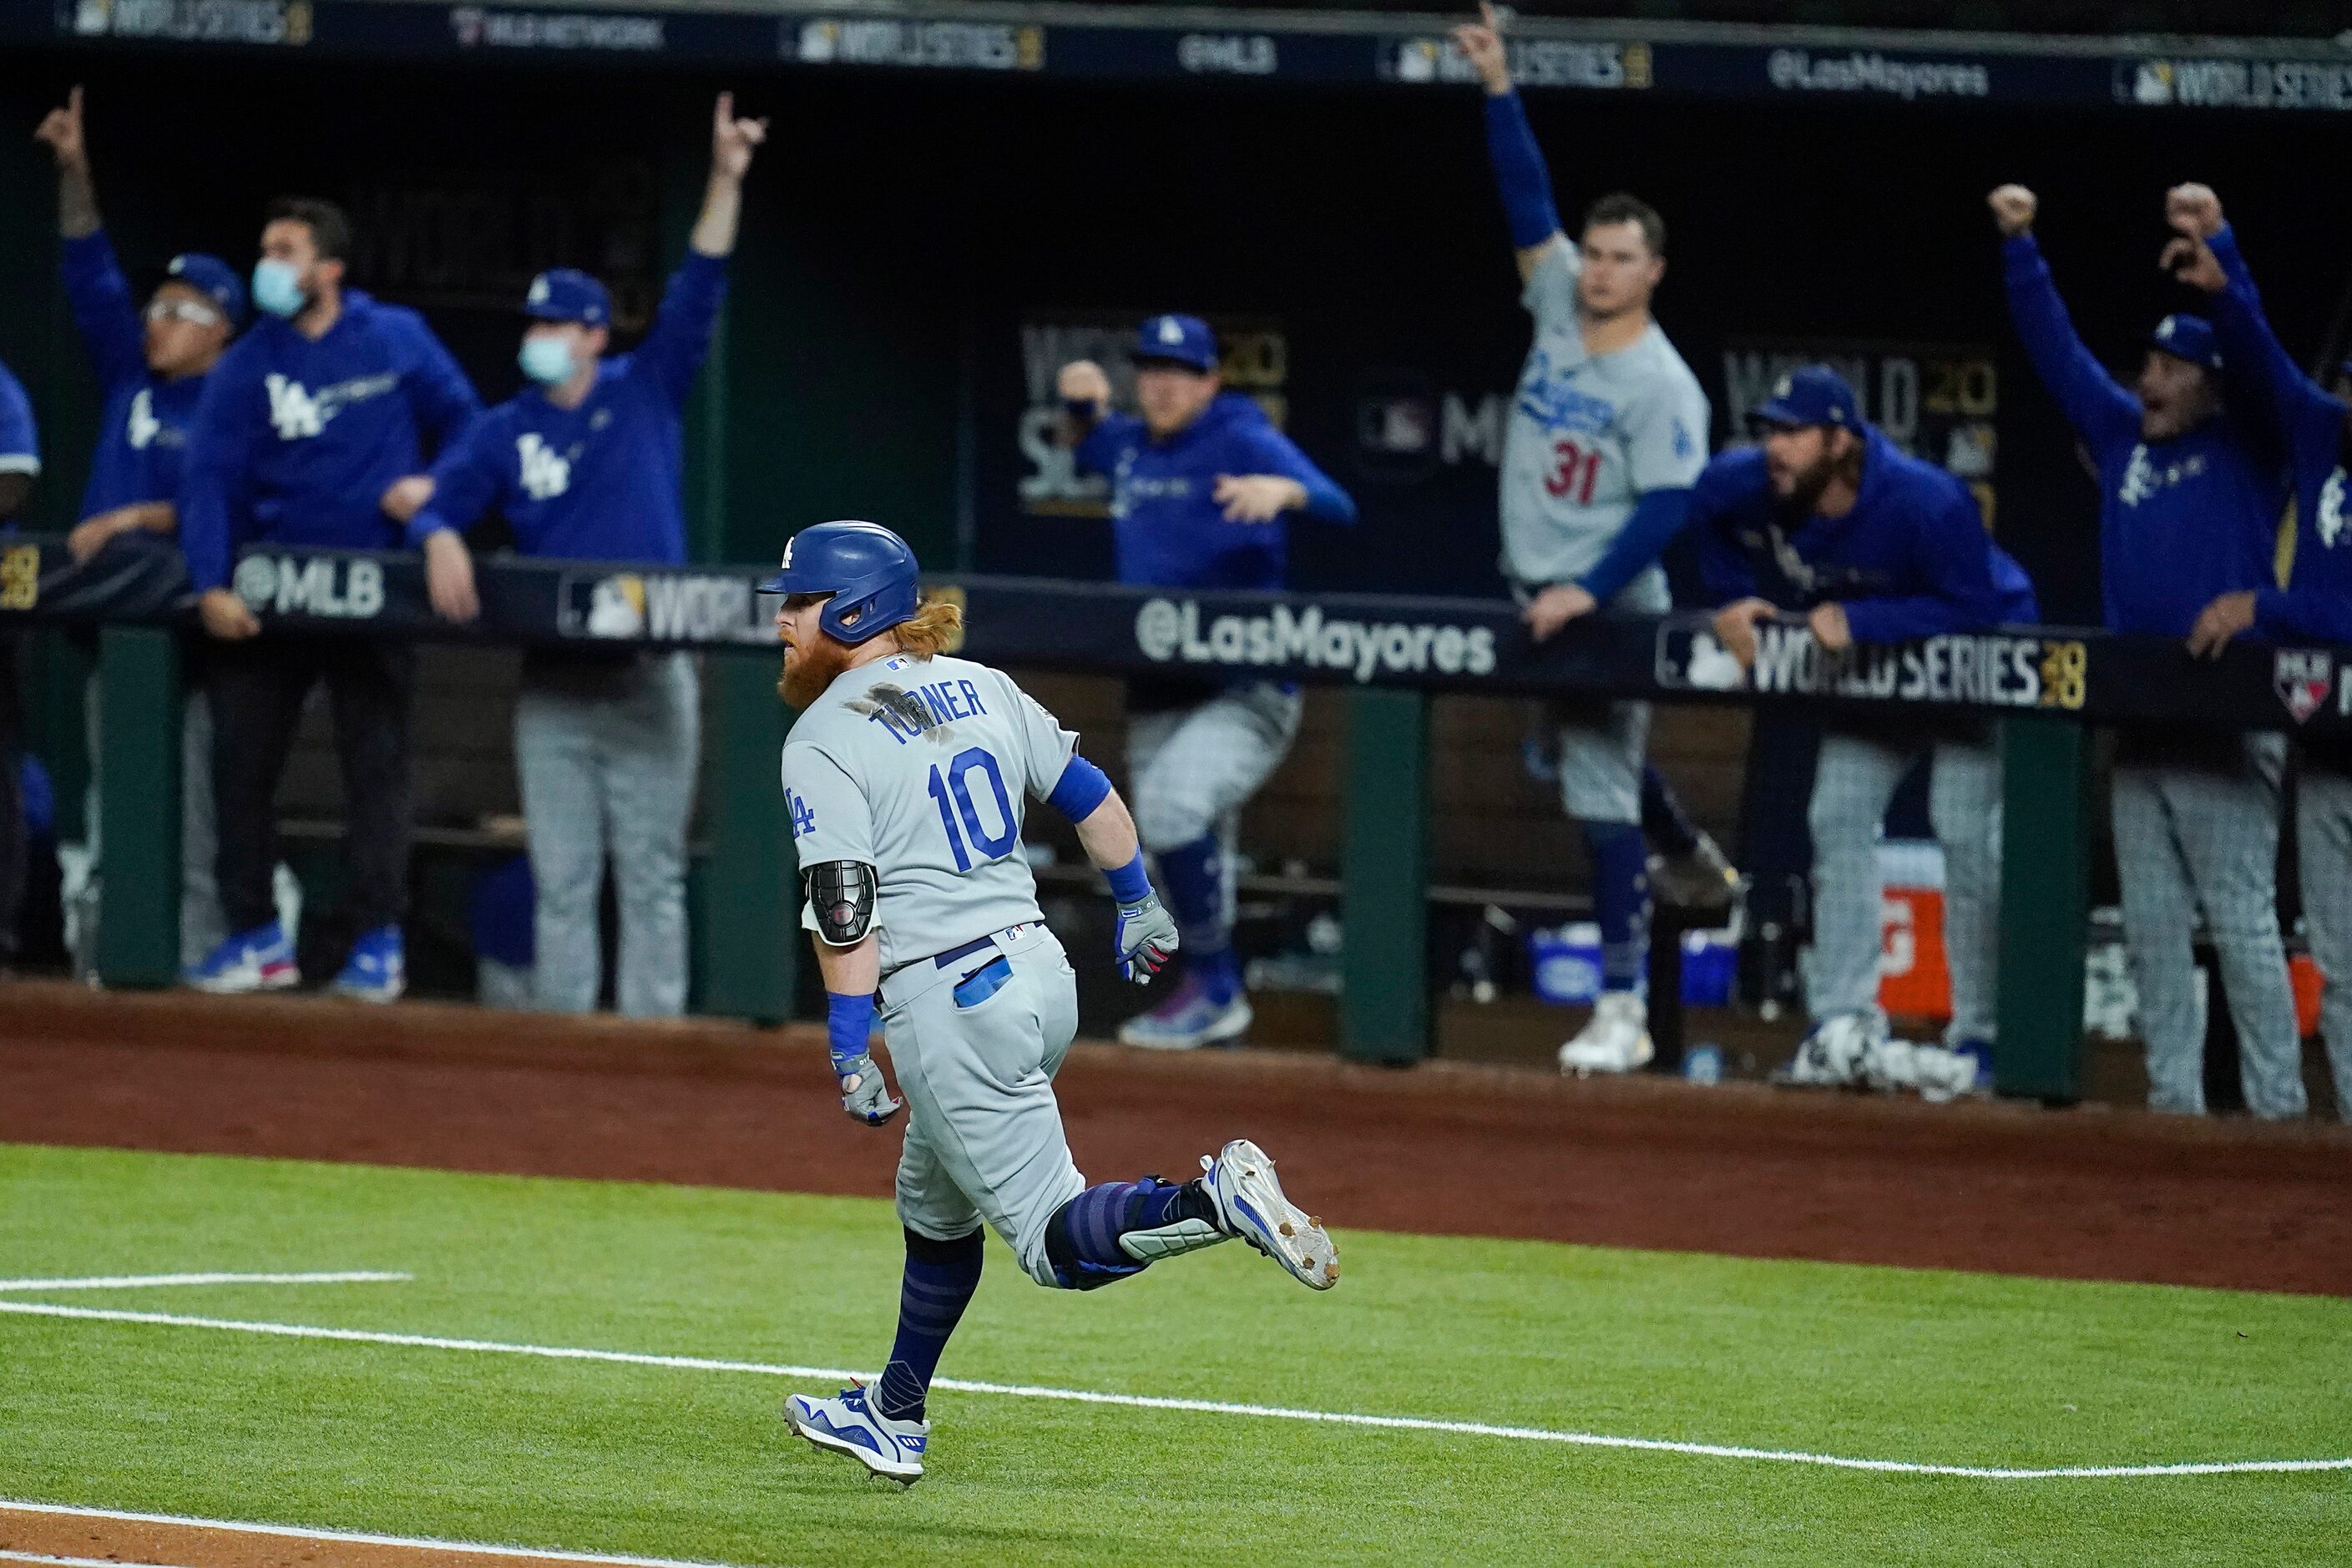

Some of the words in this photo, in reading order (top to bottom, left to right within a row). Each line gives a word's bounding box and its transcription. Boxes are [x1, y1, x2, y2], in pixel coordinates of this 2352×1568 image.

[1768, 48, 1988, 99] @LasMayores
[1543, 437, 1601, 508] 31
[233, 554, 385, 619] @MLB
[1135, 598, 1496, 684] @LasMayores
[1899, 633, 2041, 707] SERIES
[868, 680, 988, 745] TURNER
[928, 746, 1018, 873] 10
